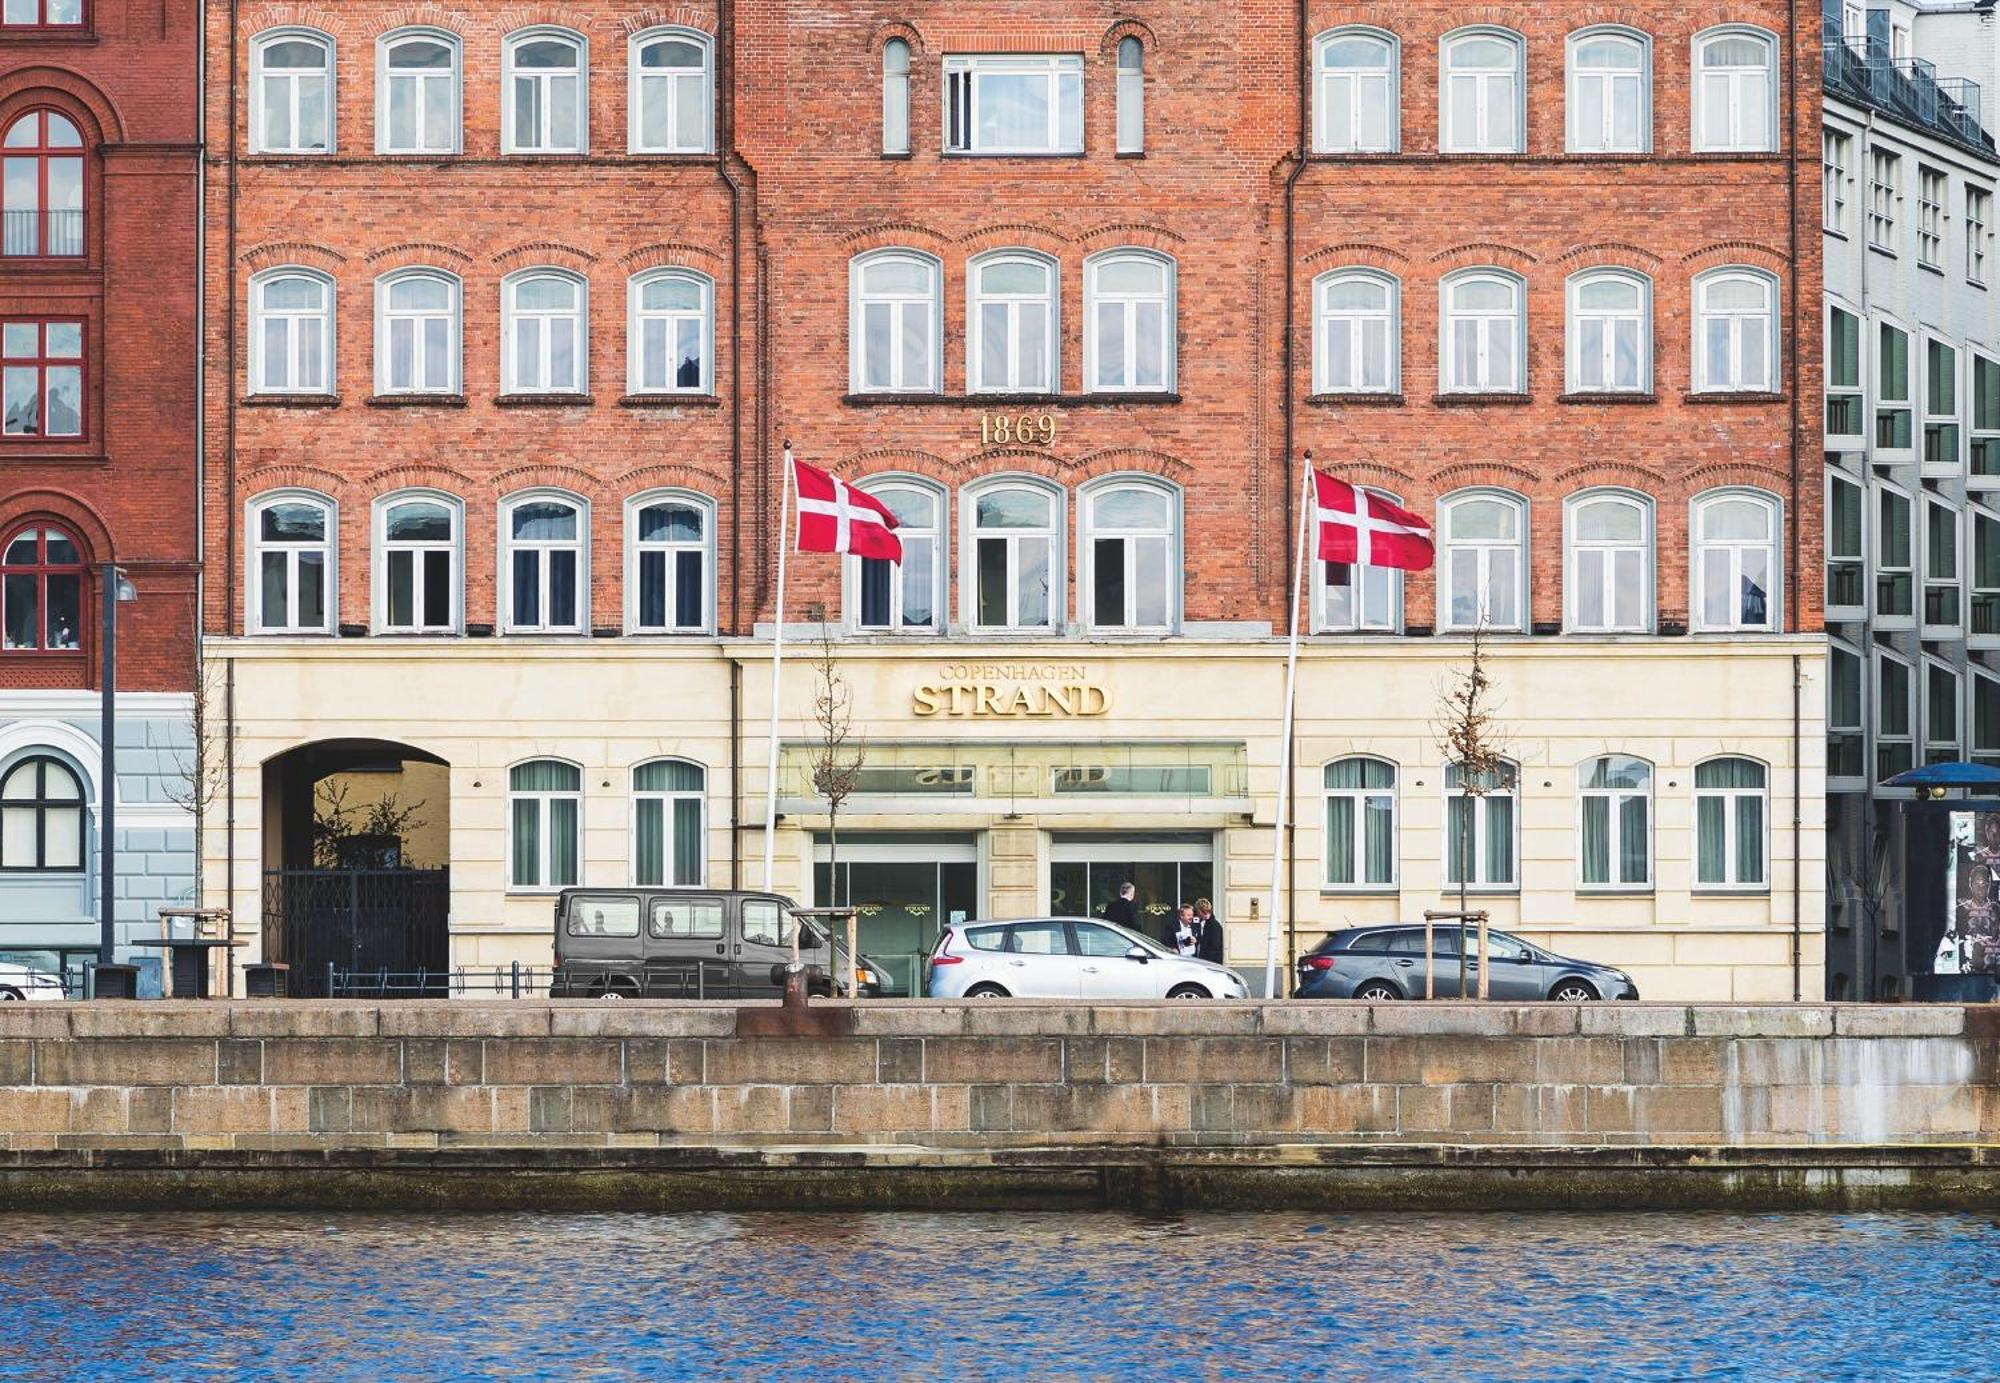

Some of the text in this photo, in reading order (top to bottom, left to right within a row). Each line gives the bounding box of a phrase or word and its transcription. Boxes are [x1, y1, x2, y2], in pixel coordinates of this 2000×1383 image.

[981, 414, 1056, 444] 1869
[939, 664, 1086, 680] COPENHAGEN
[913, 684, 1113, 716] STRAND
